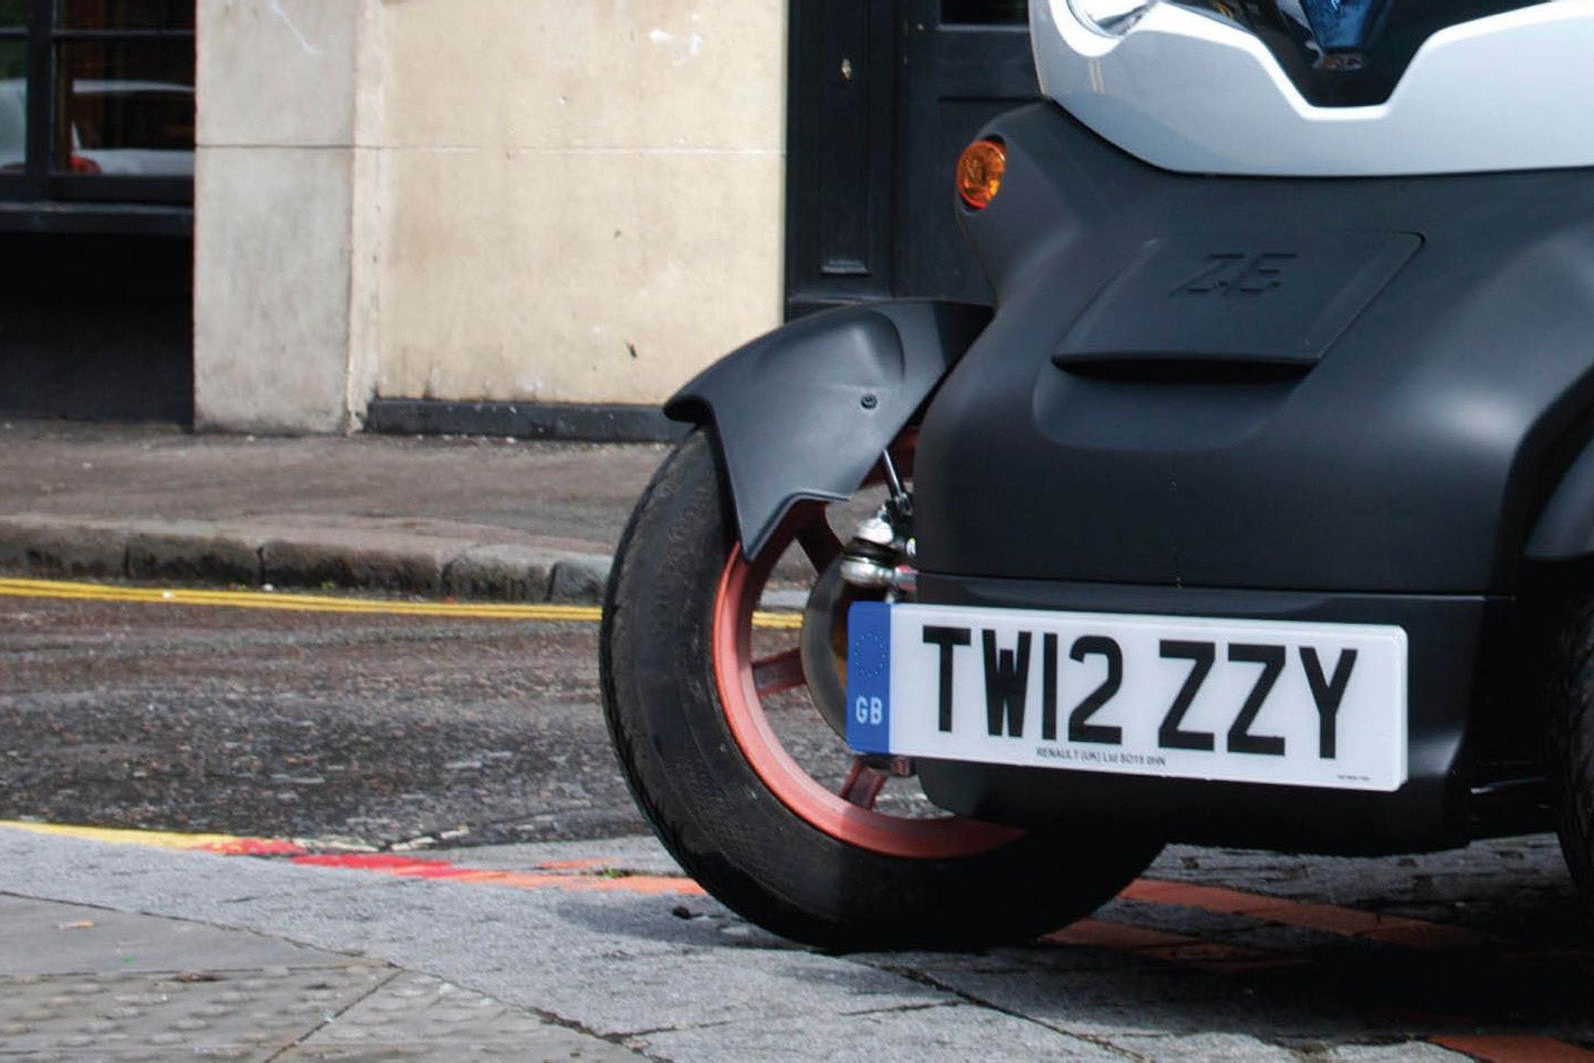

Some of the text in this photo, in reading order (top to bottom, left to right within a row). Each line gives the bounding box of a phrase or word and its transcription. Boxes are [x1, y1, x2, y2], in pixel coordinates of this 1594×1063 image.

[856, 696, 882, 724] GB
[922, 625, 1358, 759] TW12 ZZY
